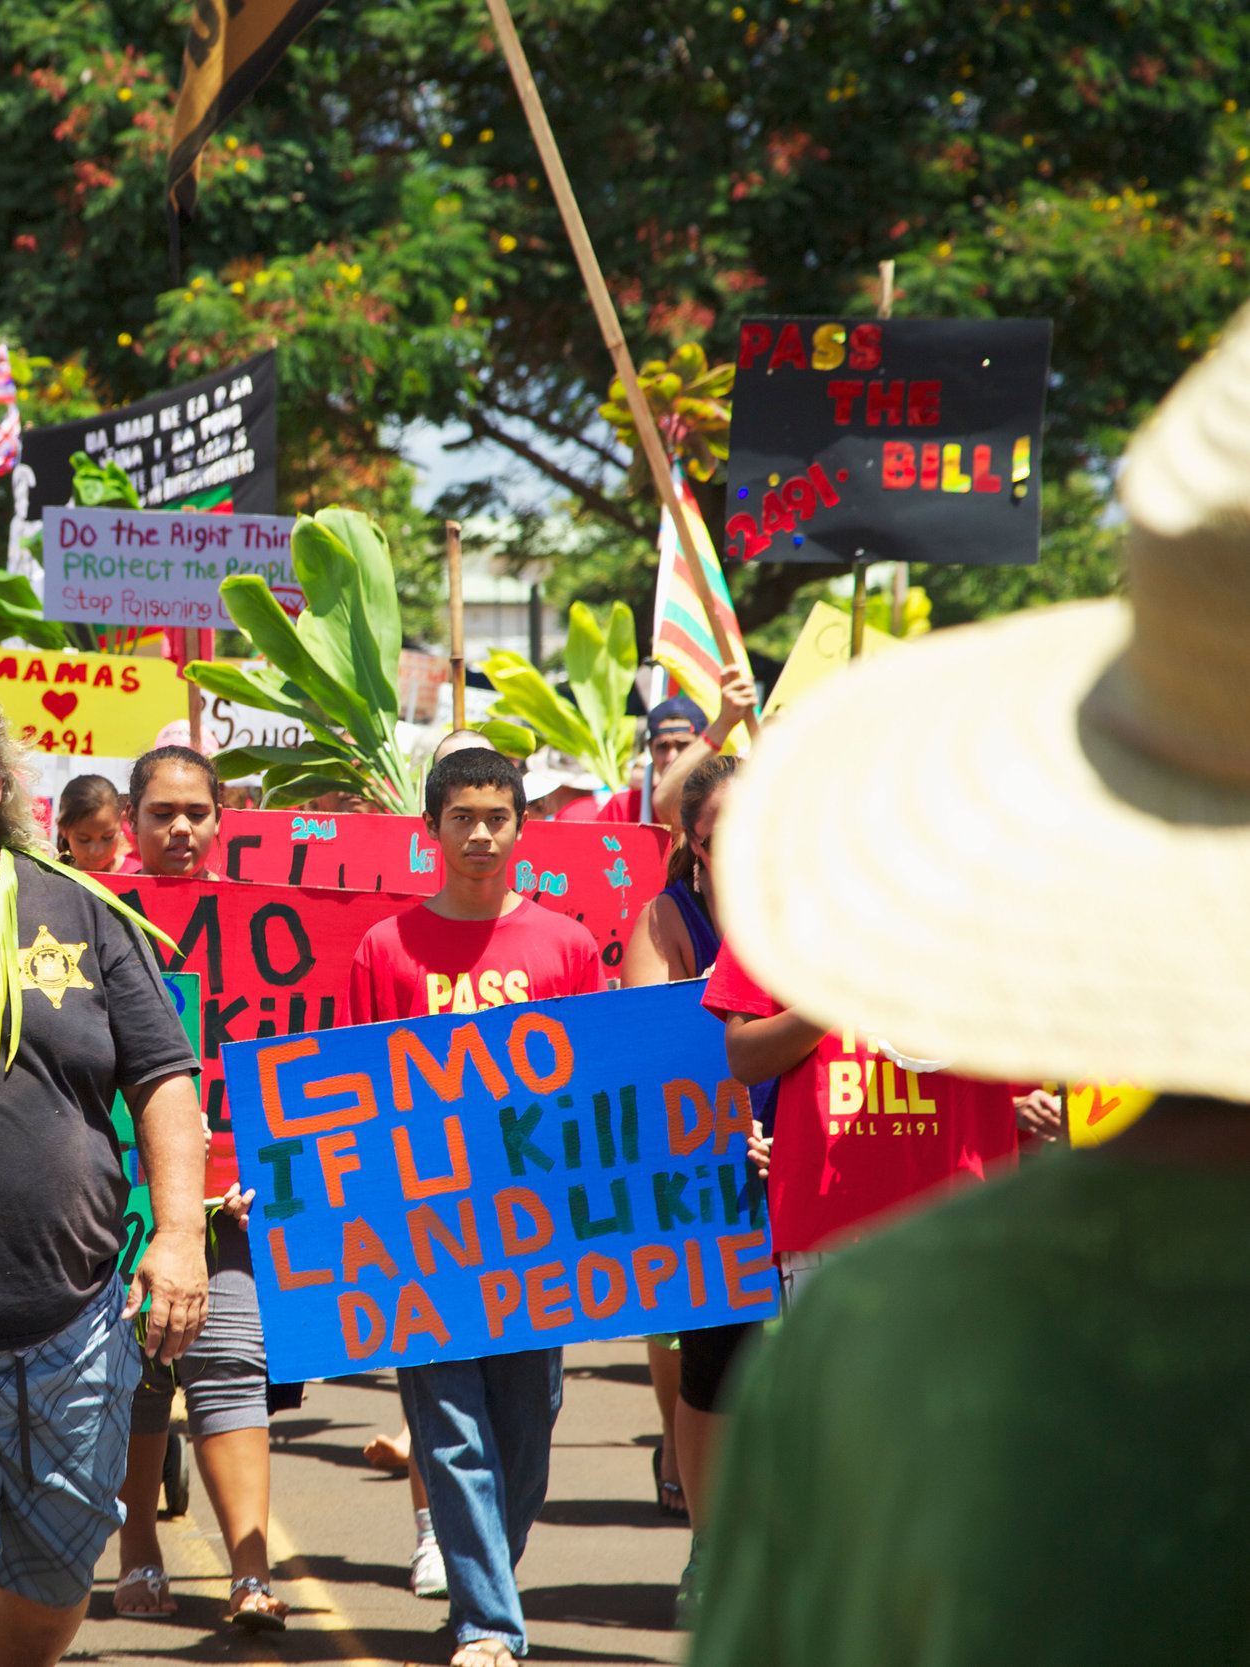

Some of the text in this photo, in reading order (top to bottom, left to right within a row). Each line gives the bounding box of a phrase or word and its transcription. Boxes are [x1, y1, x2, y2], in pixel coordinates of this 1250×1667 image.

[737, 323, 883, 371] PASS
[827, 380, 942, 426] THE
[59, 517, 292, 552] Do the Right Thin
[62, 586, 113, 615] Stop
[121, 589, 212, 621] Poisoning
[22, 725, 94, 756] 2491
[257, 1012, 574, 1139] GMO
[829, 1060, 937, 1114] BILL
[258, 1131, 361, 1220] IF
[391, 1115, 471, 1200] U
[662, 1076, 753, 1155] DA
[829, 1121, 877, 1135] BILL
[268, 1186, 555, 1291] LAND
[568, 1177, 635, 1241] U
[337, 1279, 451, 1360] DA
